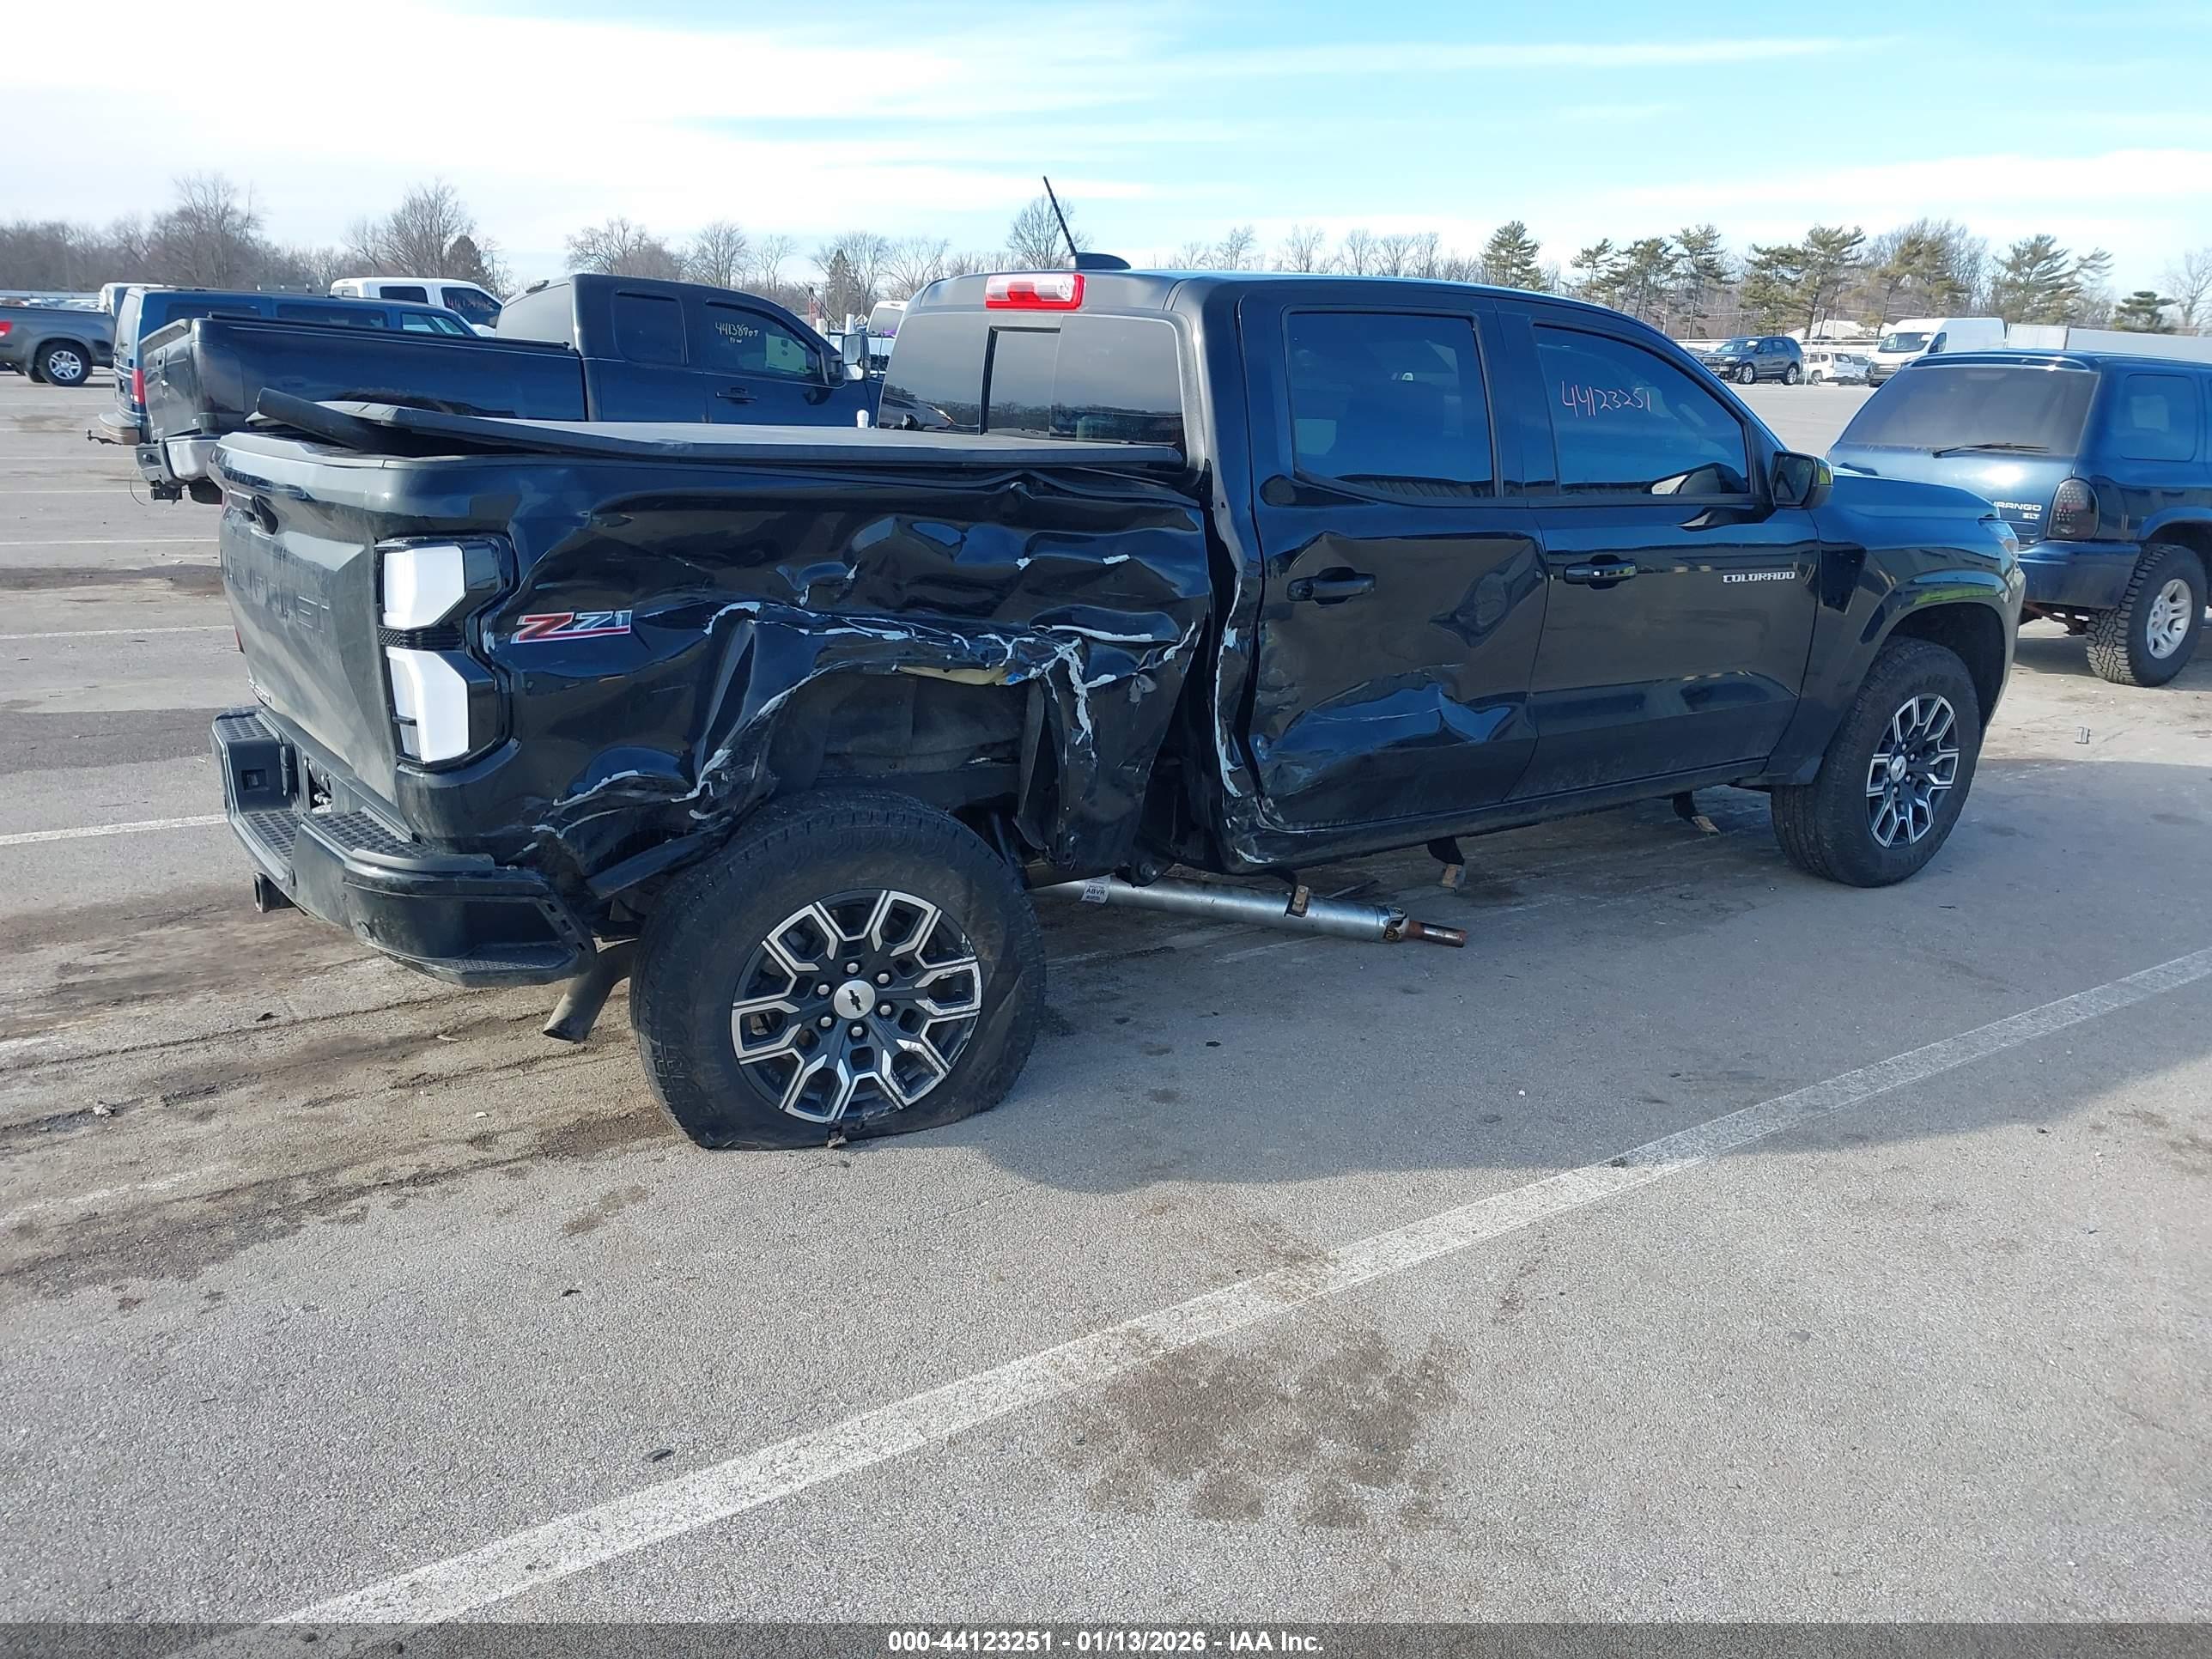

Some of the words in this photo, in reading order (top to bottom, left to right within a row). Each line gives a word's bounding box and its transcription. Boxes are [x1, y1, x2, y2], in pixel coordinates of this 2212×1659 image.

[1562, 380, 1650, 417] 44123251
[1723, 571, 1796, 583] COLORADO
[511, 610, 633, 644] Z71
